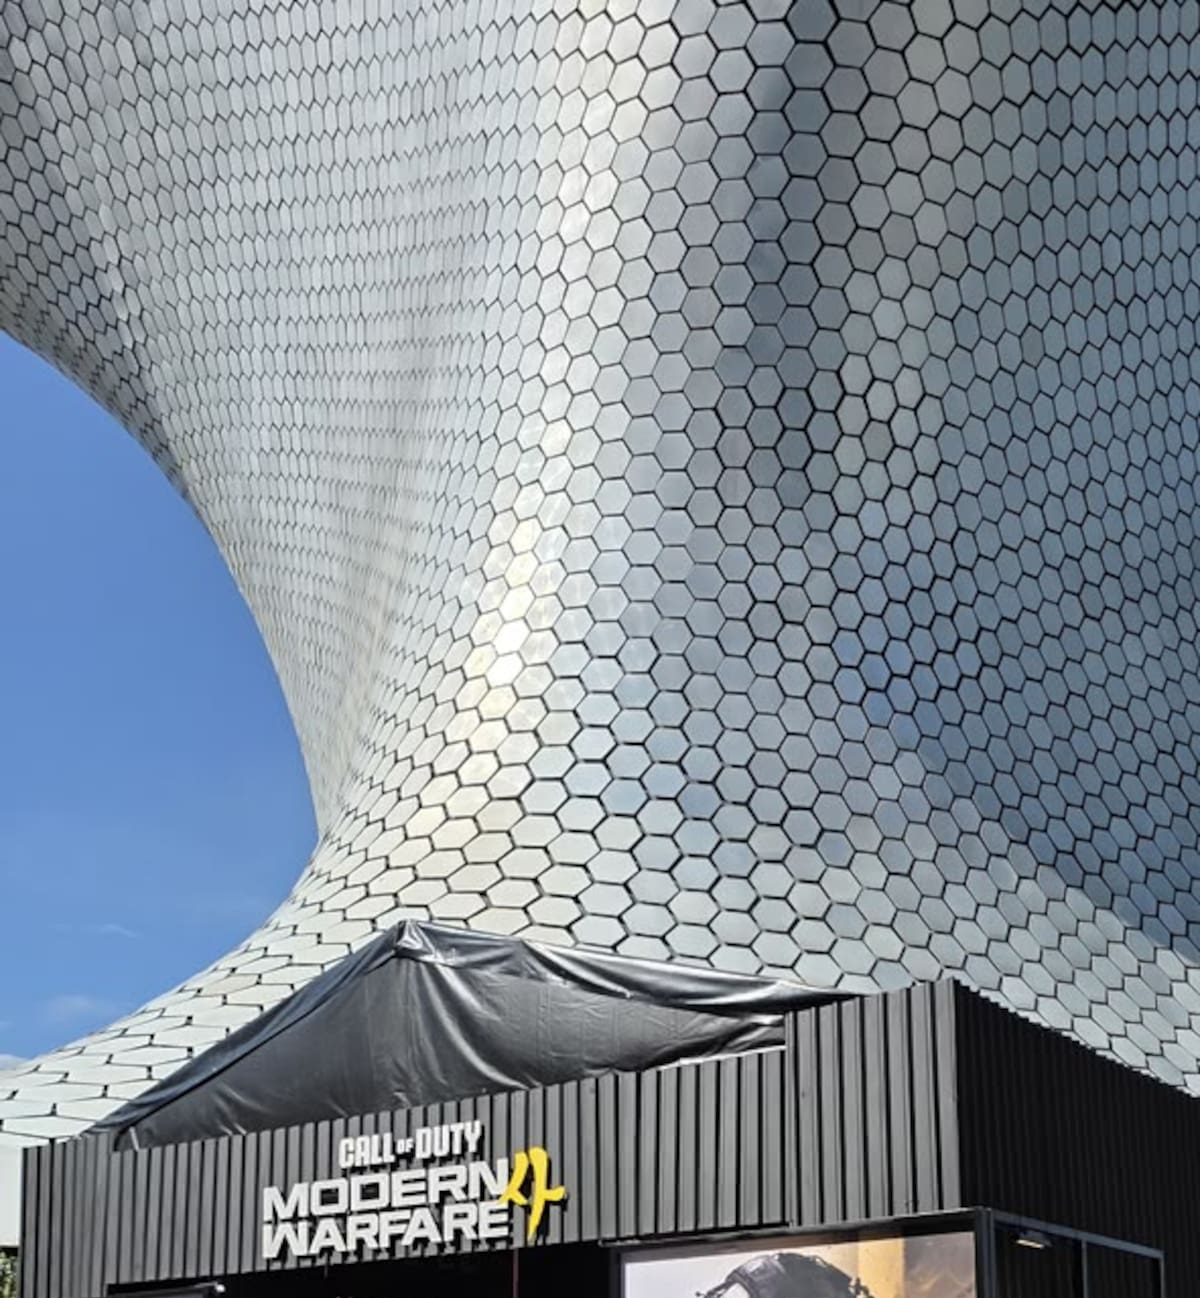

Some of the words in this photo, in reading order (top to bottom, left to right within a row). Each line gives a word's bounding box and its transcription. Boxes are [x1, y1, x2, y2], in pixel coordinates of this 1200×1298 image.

[339, 1133, 395, 1169] CALL
[397, 1137, 414, 1155] OF
[415, 1120, 481, 1160] DUTY
[262, 1157, 509, 1223] MODERN
[499, 1146, 566, 1243] 4
[262, 1200, 509, 1259] WARFARE
